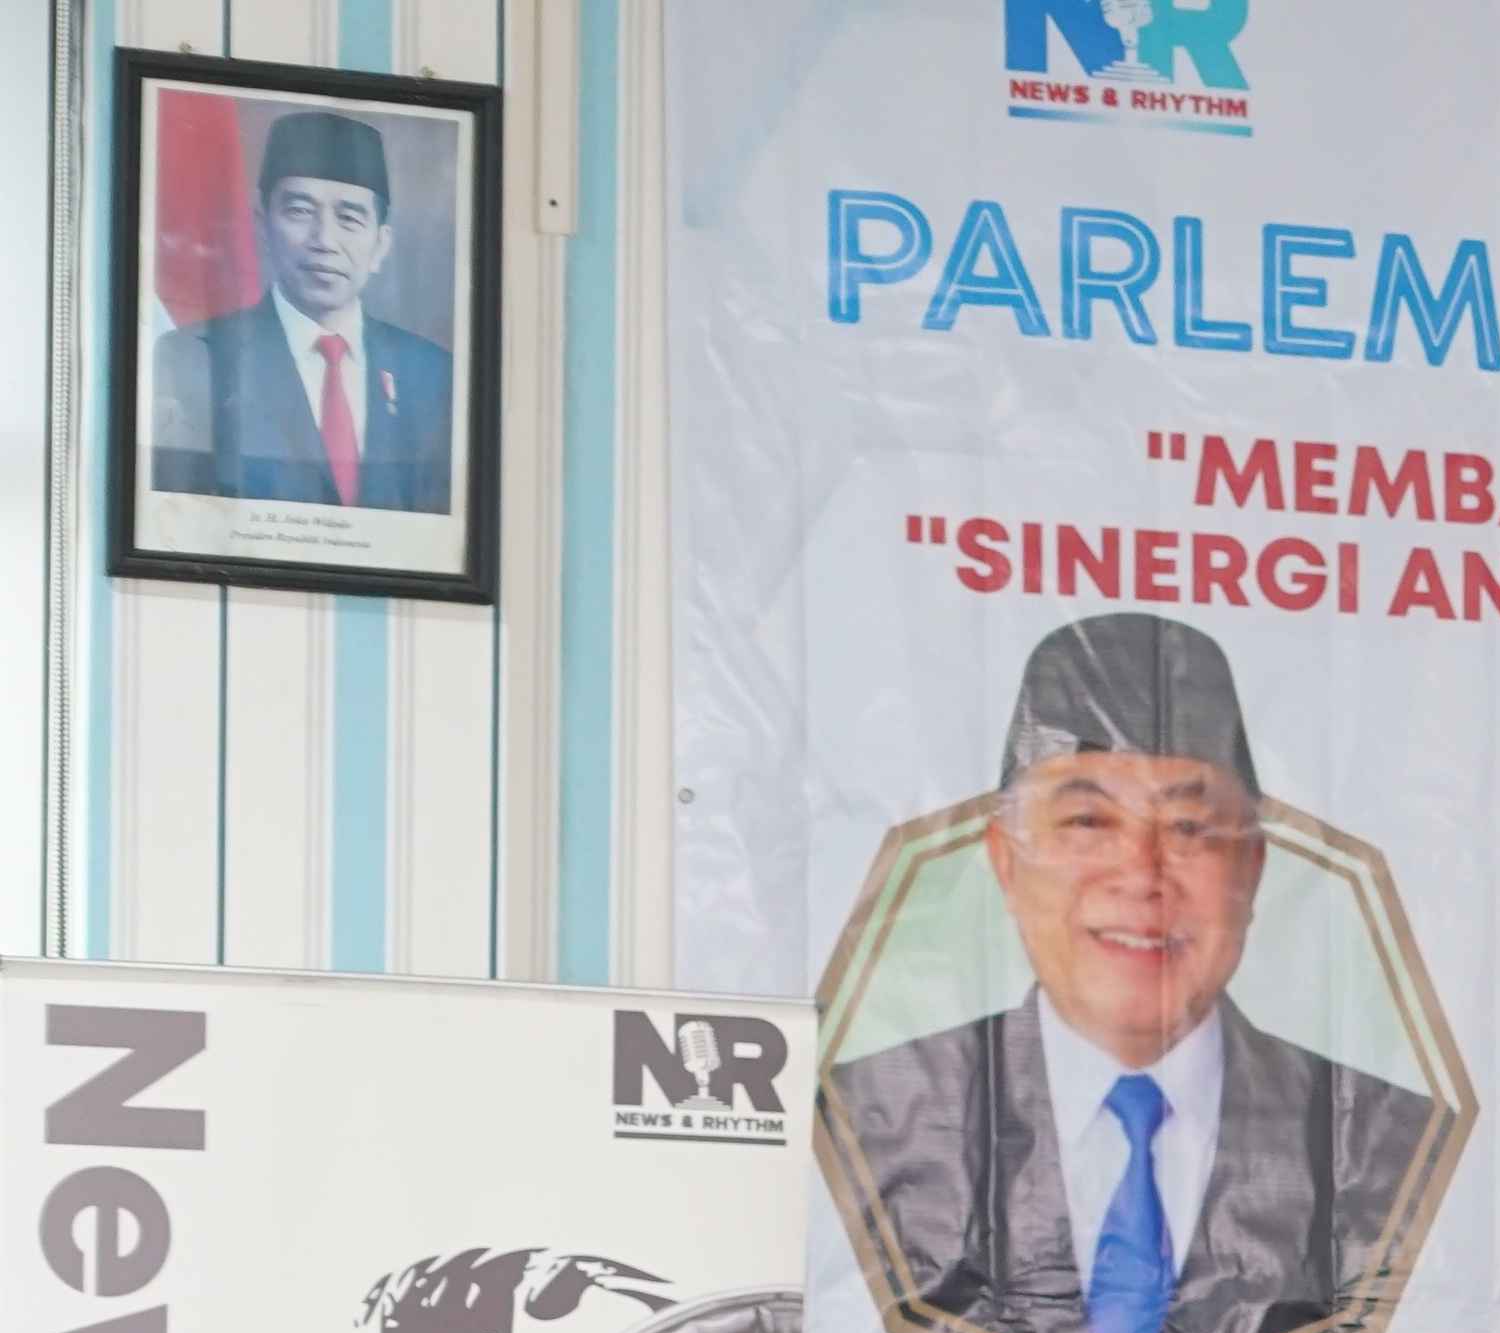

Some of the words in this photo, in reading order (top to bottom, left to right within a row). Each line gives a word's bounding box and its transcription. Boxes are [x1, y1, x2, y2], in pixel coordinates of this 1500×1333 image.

[1009, 78, 1090, 105] NEWS
[1102, 86, 1119, 108] &
[1131, 89, 1249, 118] RHYTHM
[907, 516, 1359, 614] "SINERGI
[615, 1112, 672, 1127] NEWS
[681, 1115, 694, 1128] &
[702, 1116, 784, 1132] RHYTHM
